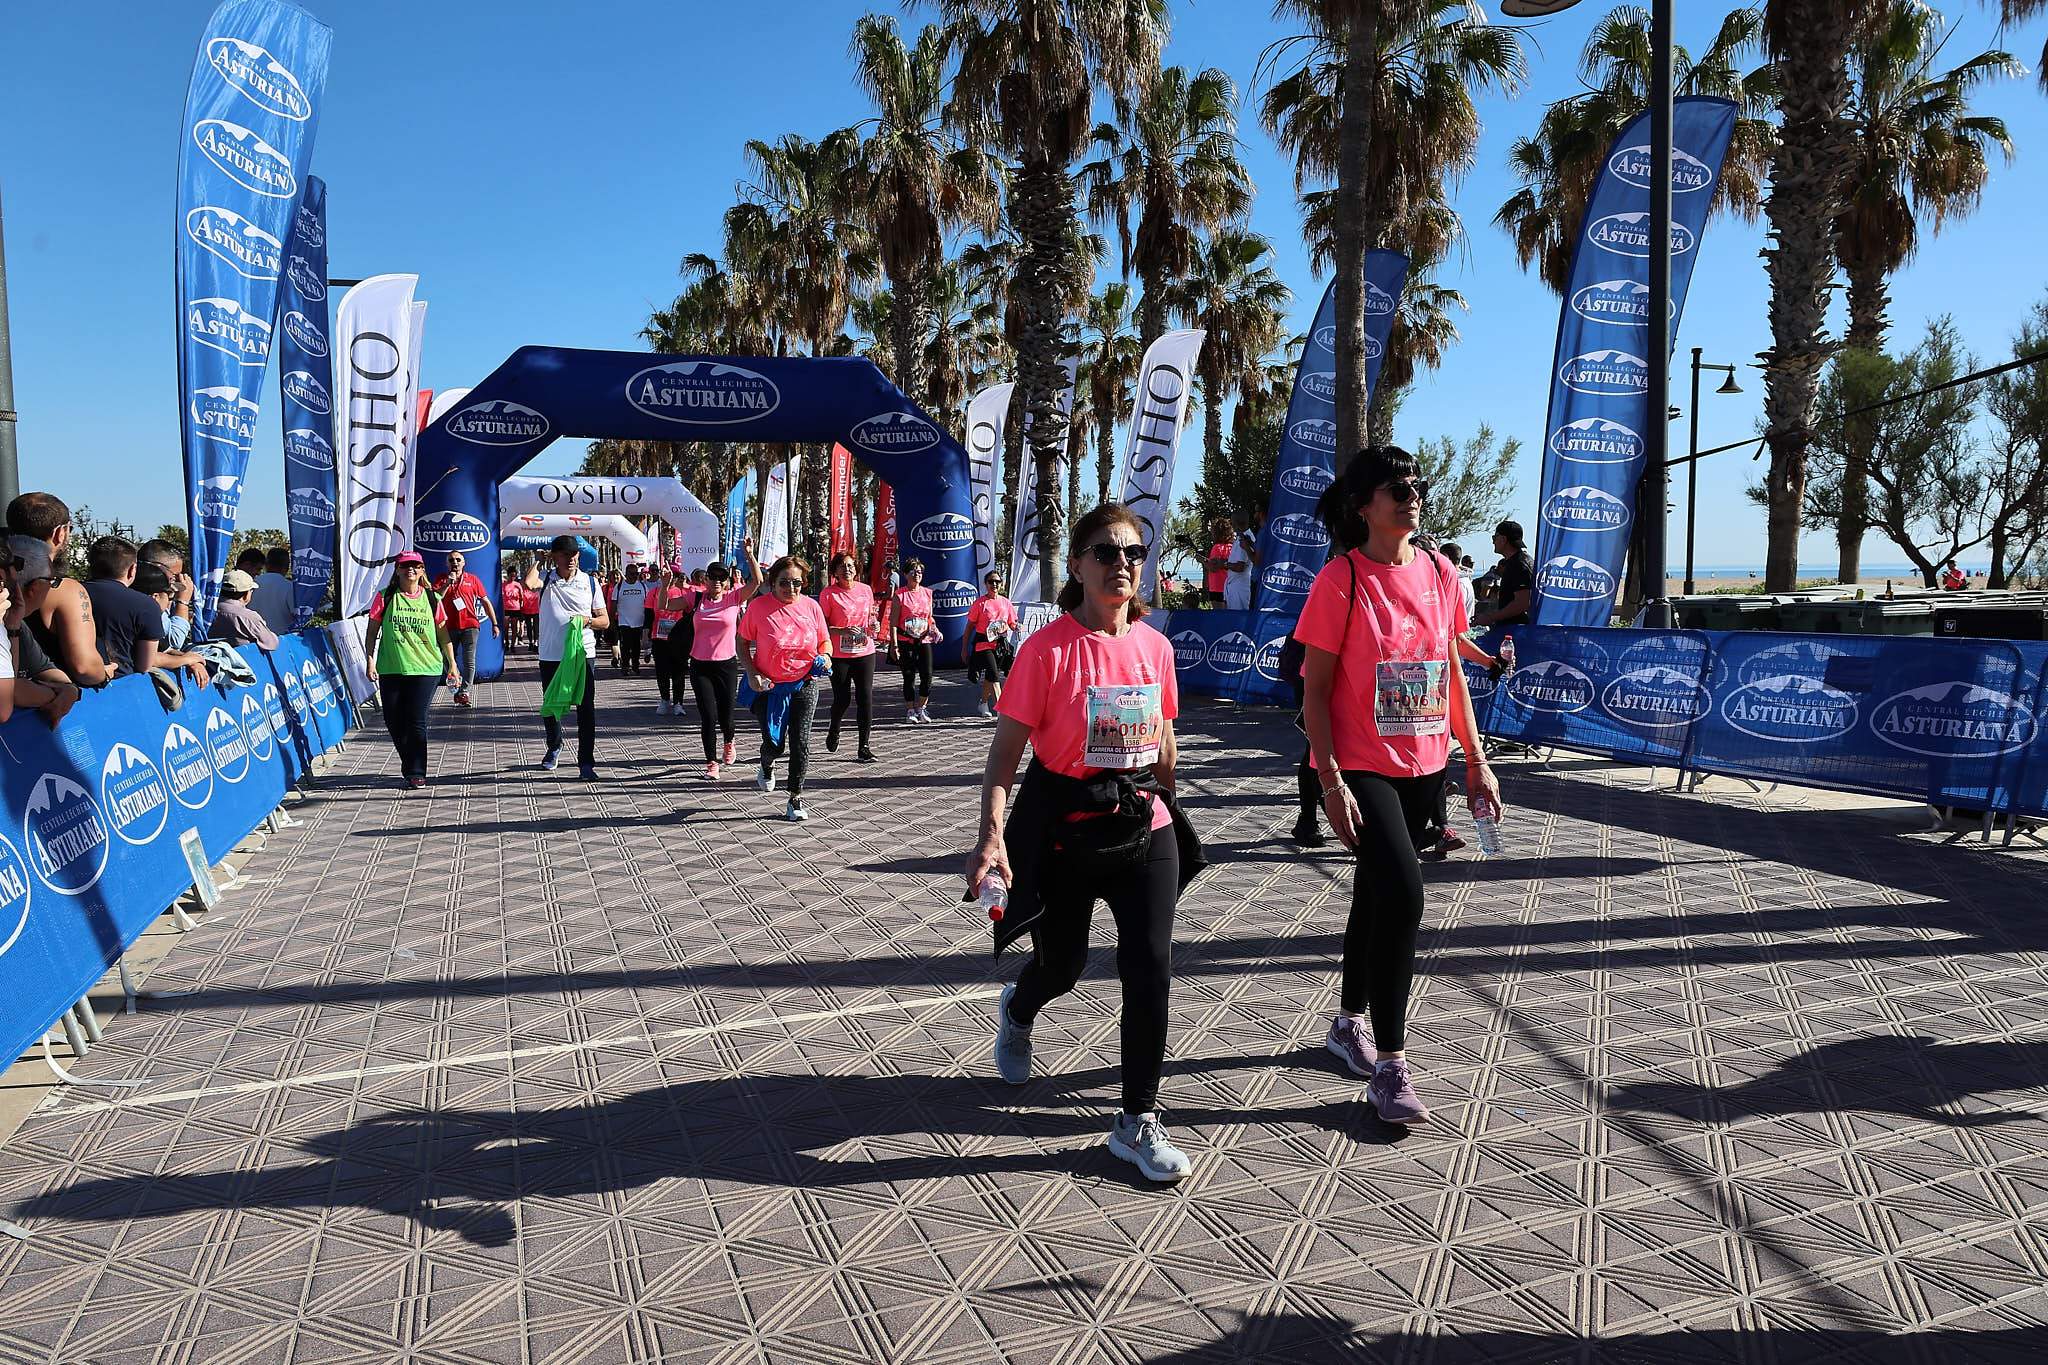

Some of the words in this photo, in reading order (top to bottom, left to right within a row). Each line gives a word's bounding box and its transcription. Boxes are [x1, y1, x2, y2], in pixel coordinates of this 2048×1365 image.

[1578, 293, 1648, 316] ASTURIA
[1582, 363, 1612, 371] CENTRAL
[287, 379, 328, 409] ASTURIANA
[638, 378, 769, 409] ASTURIANA
[662, 377, 710, 387] CENTRAL
[715, 380, 764, 388] LECHERA
[452, 416, 542, 435] ASTURIANA
[858, 429, 936, 444] ASTURIANA
[287, 436, 332, 466] ASTURIANA
[348, 331, 404, 568] OYSHO
[1556, 433, 1635, 456] ASTURIANA
[538, 484, 642, 504] OYSHO
[834, 454, 847, 519] Santander
[671, 506, 701, 514] OYSHO
[1548, 501, 1621, 523] ASTURIANA
[414, 527, 485, 543] ASTURIANA
[916, 529, 974, 542] ASTURIANA
[1273, 521, 1327, 543] ASTURIANA
[687, 546, 715, 554] OYSHO
[1210, 645, 1251, 664] ASTURIANA
[1511, 677, 1586, 704] ASTURIANA
[1608, 686, 1700, 714] ASTURIANA
[1754, 695, 1796, 704] CENTRAL
[1731, 695, 1846, 728] ASTURIANA
[1908, 704, 1959, 716] CENTRAL
[1964, 708, 2020, 720] LECHERA
[1881, 705, 2022, 743] ASTURIANA
[114, 774, 134, 793] CENTRAL
[134, 768, 154, 784] LECHERA
[168, 757, 210, 795] ASTURIANA
[41, 813, 66, 833] CENTRAL
[66, 801, 92, 820] LECHERA
[109, 782, 165, 829] ASTURIANA
[33, 815, 106, 878] ASTURIANA
